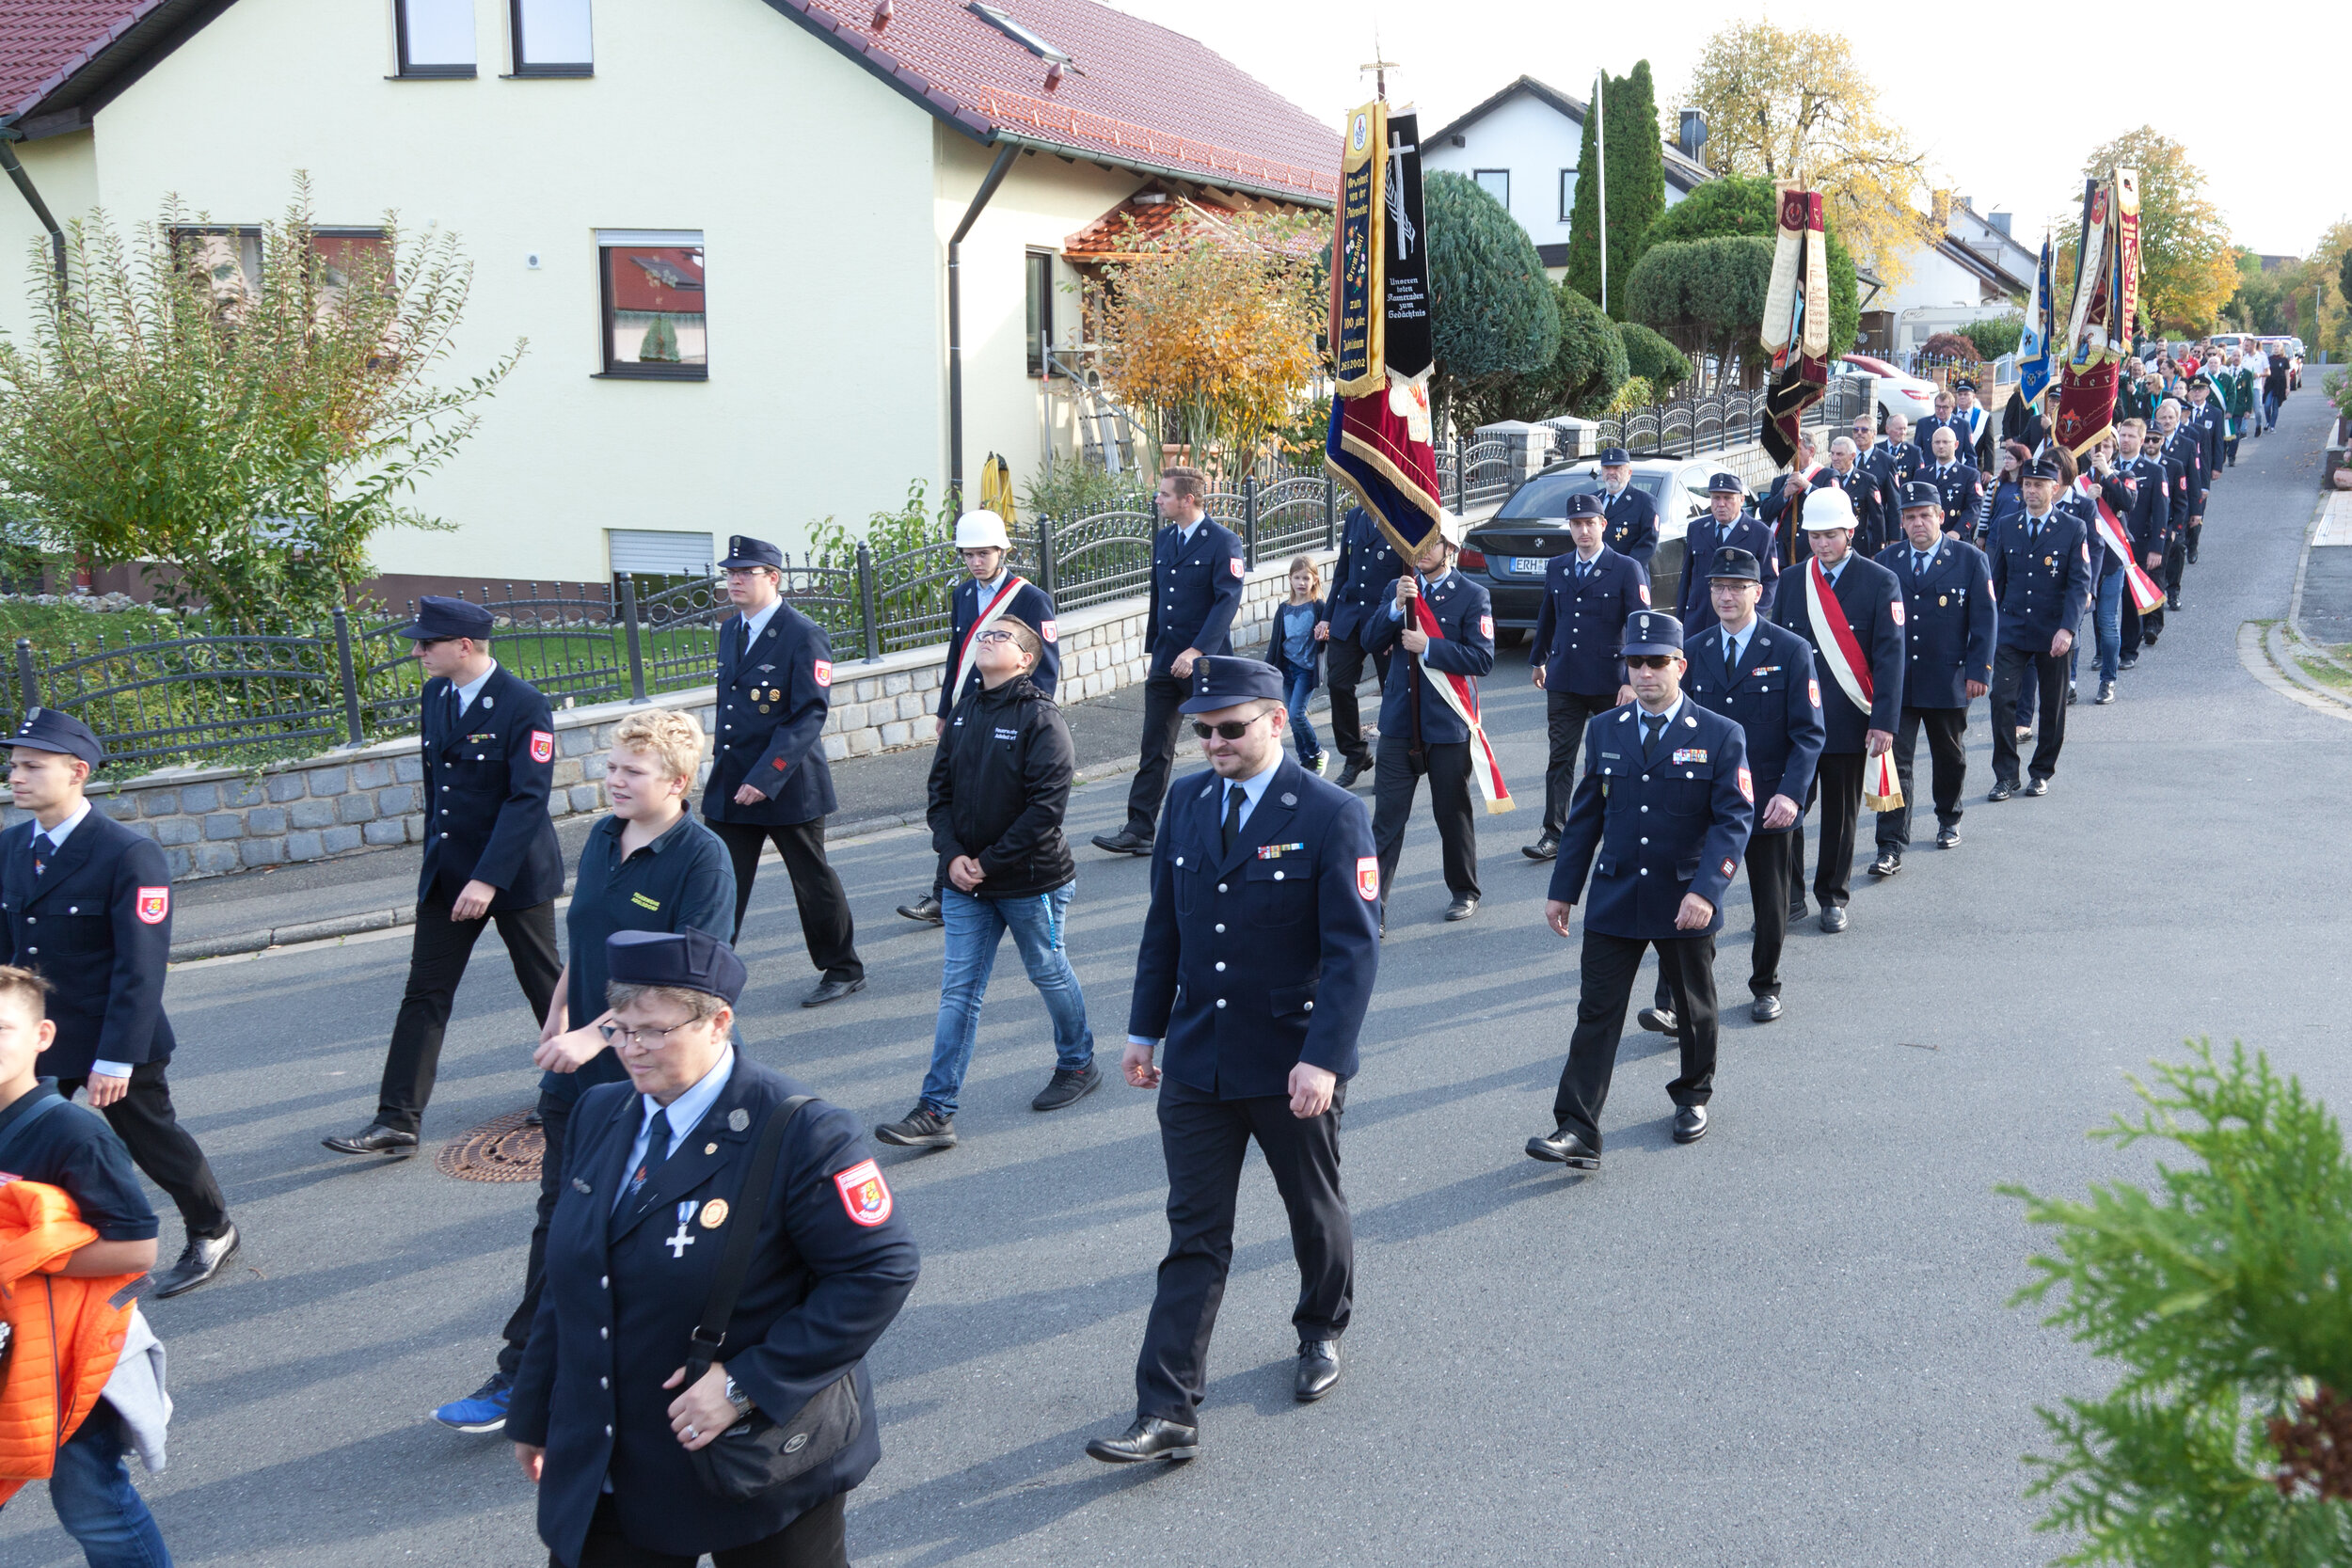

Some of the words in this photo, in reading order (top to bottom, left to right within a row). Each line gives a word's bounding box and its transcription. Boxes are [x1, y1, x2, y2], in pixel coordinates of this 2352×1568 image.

[1390, 277, 1419, 286] Unseren
[1387, 292, 1424, 301] Kameraden
[1399, 302, 1414, 310] zum
[1388, 309, 1426, 319] Gedächtnis
[1343, 317, 1354, 330] 100
[1517, 559, 1537, 570] ERH
